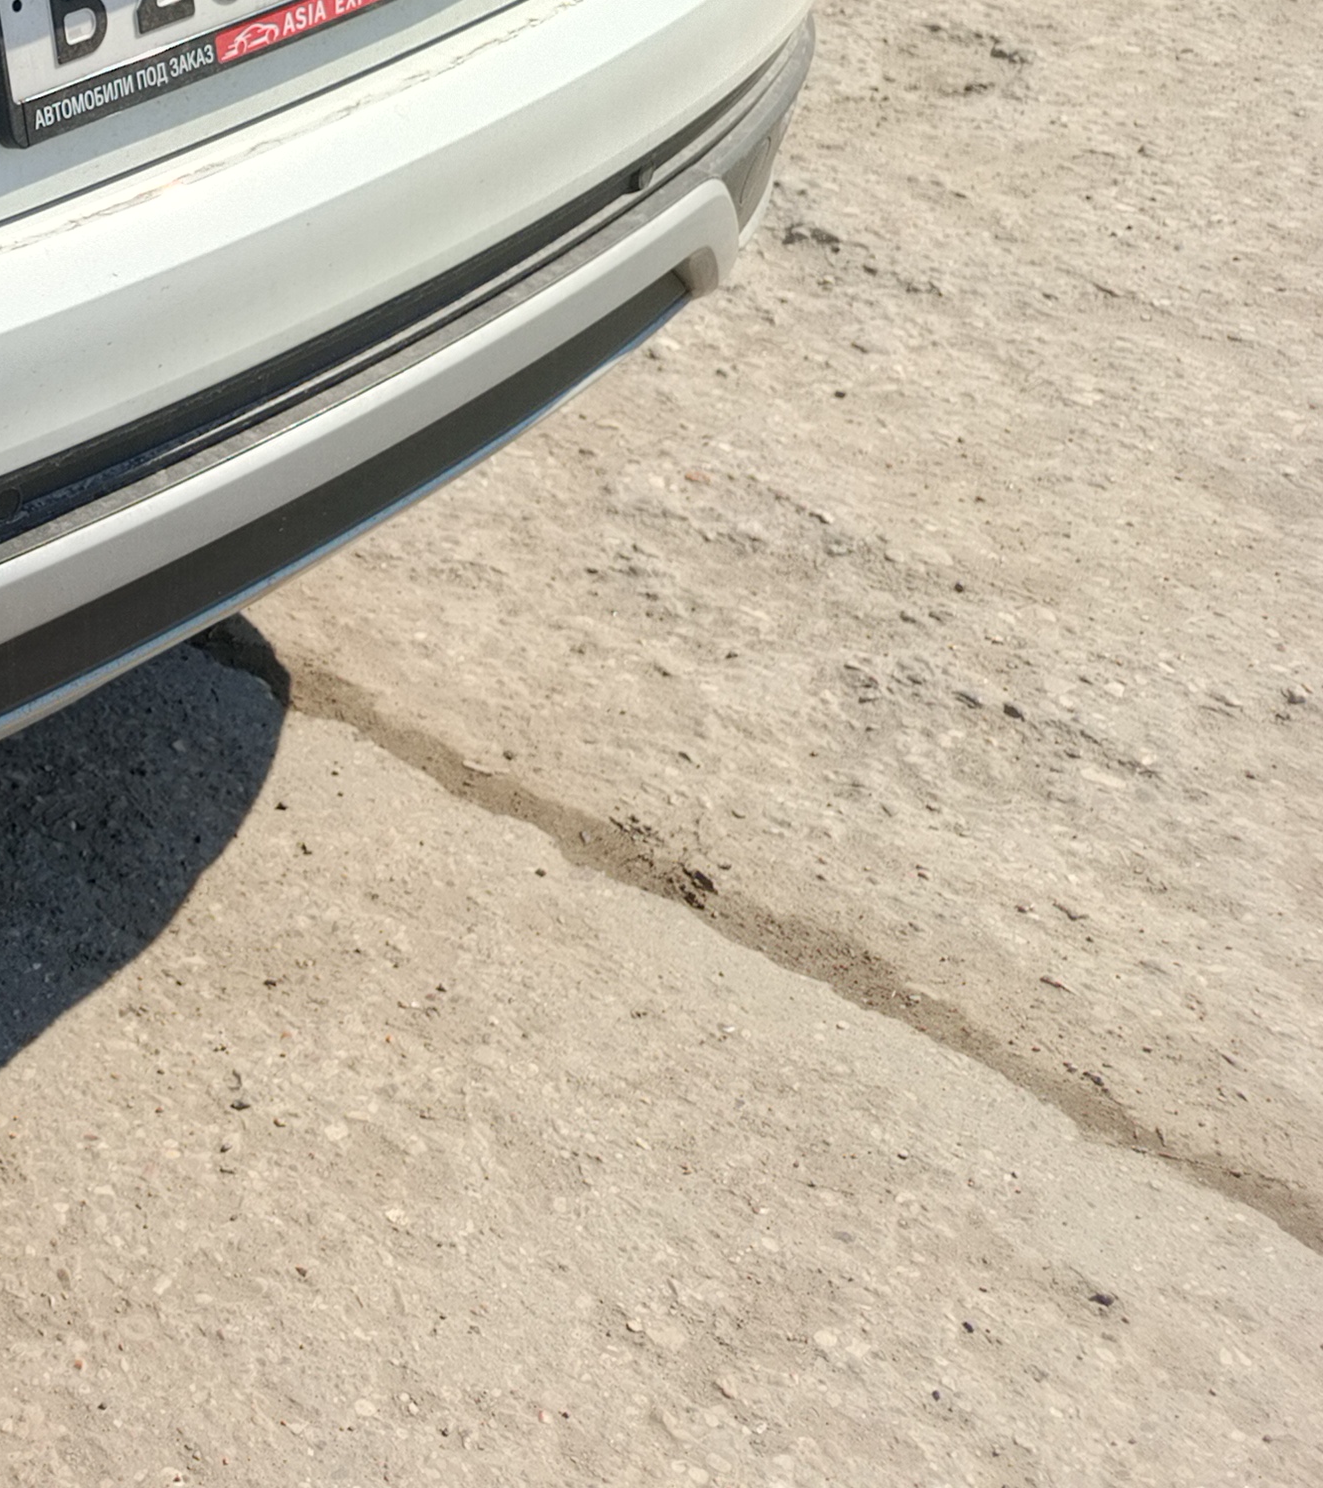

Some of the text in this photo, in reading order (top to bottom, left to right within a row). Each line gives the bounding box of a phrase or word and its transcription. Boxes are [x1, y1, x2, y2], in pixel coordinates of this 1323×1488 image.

[282, 0, 327, 36] ASIA
[34, 44, 215, 130] АВТОМОБИЛИ ПОД ЗАКАЗ
